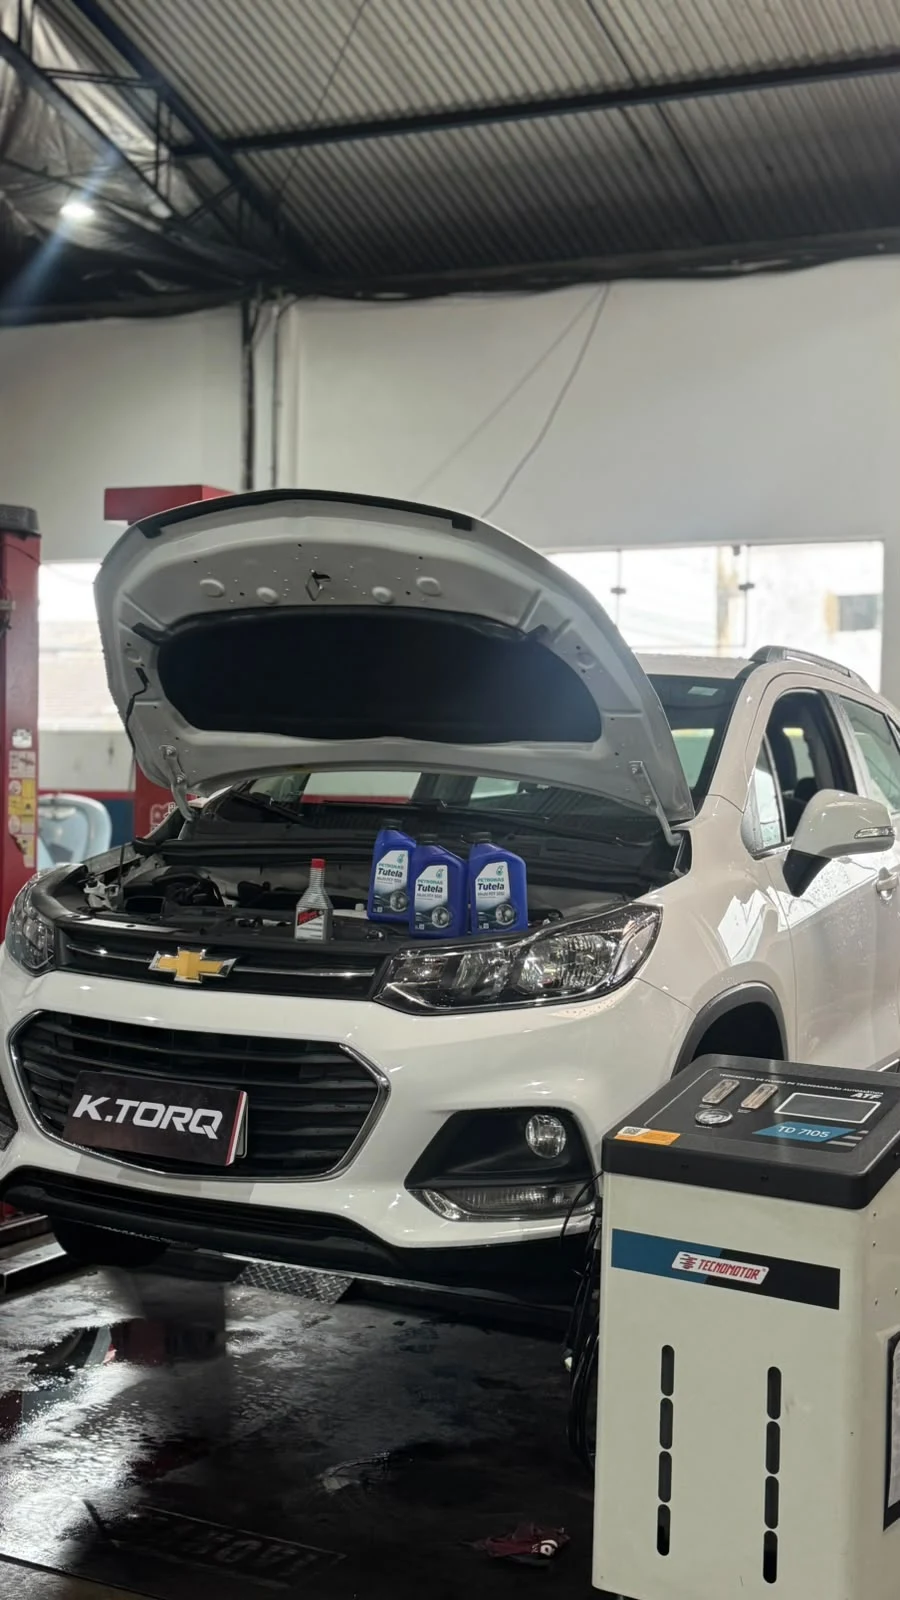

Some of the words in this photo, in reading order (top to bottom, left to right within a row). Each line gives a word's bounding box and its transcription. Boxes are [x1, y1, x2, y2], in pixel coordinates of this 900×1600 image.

[378, 868, 403, 877] Tutela
[417, 884, 443, 893] Tutela
[477, 883, 504, 891] Tutela
[72, 1094, 223, 1140] K.TORQ
[778, 1125, 796, 1134] TD
[801, 1128, 830, 1138] 7105
[698, 1260, 760, 1280] TECNOMOTOR
